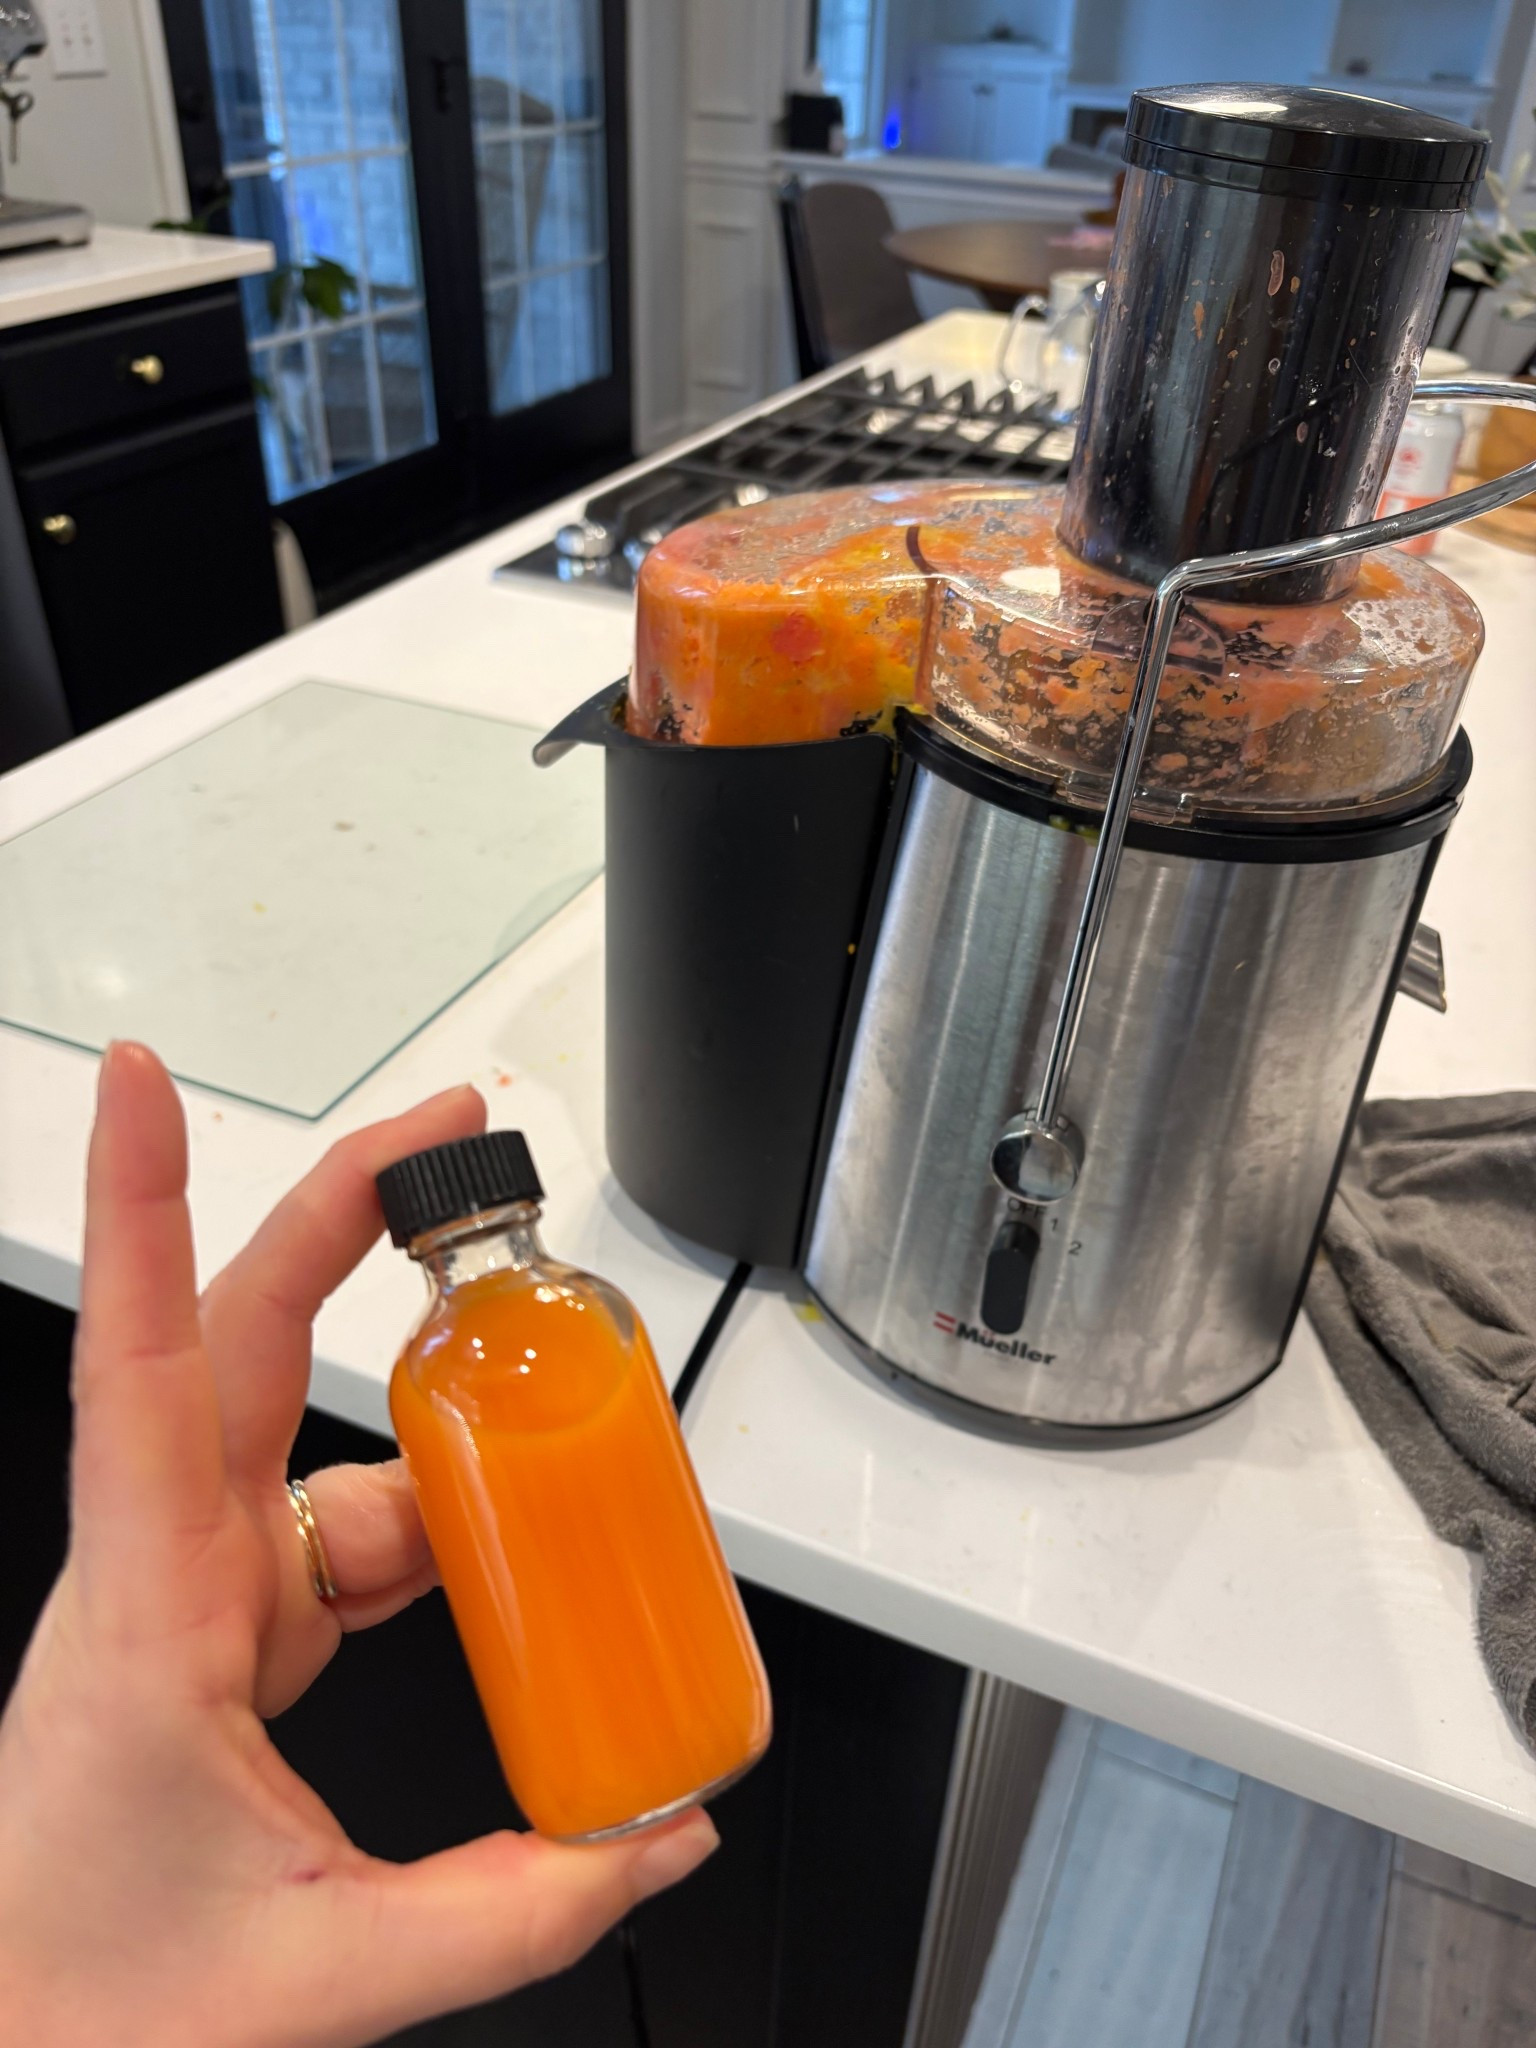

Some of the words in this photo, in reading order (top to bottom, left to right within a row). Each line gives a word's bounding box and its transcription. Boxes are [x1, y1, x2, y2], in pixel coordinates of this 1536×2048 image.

[1007, 1197, 1047, 1218] OFF
[1050, 1218, 1058, 1231] 1
[1068, 1240, 1082, 1256] 2
